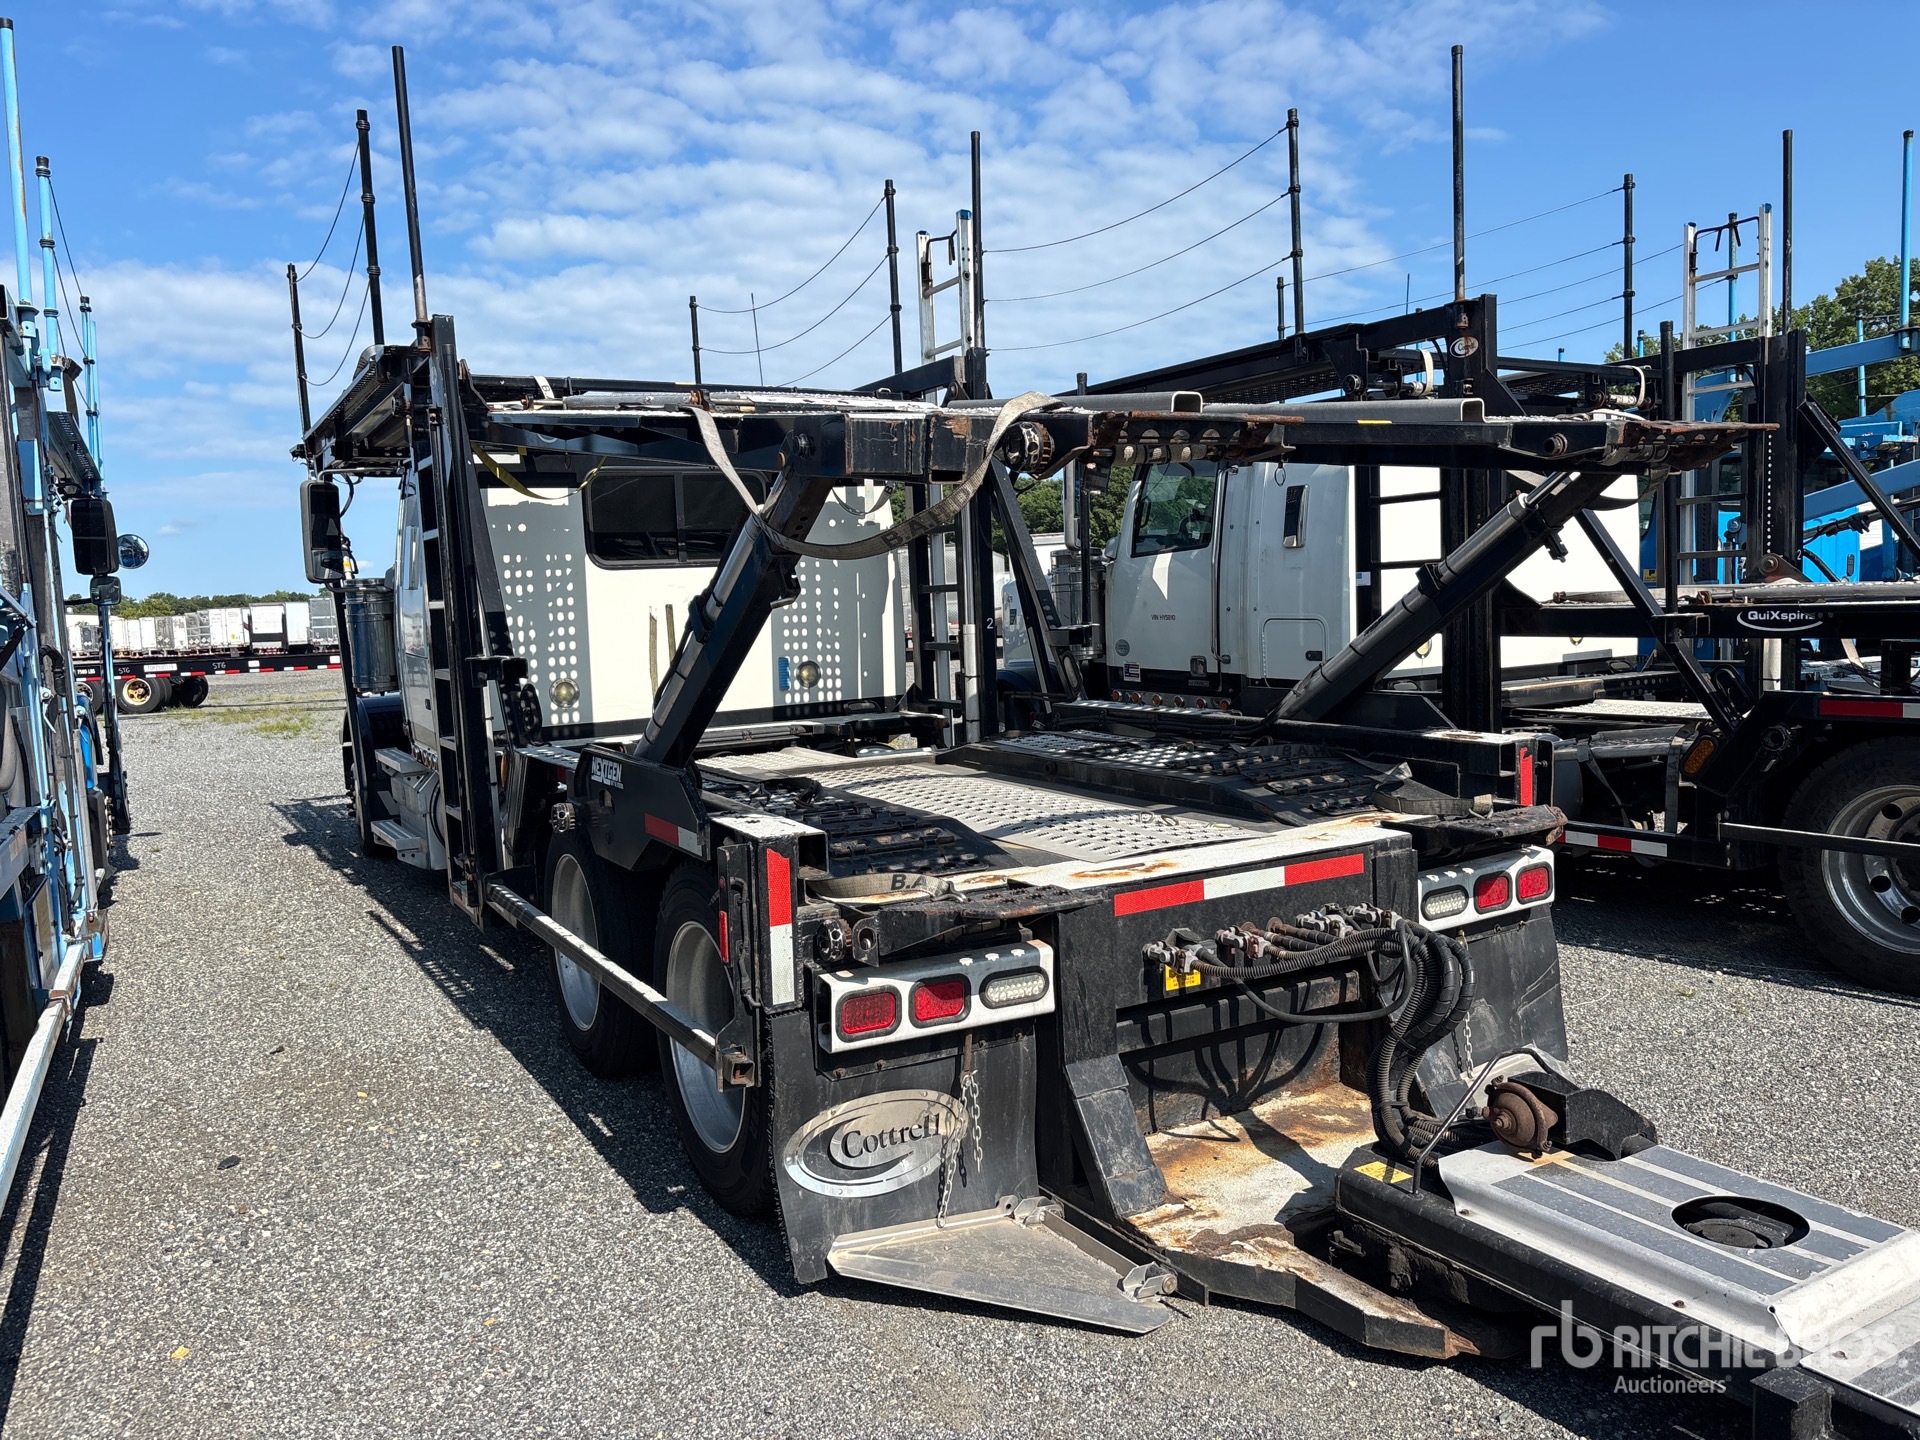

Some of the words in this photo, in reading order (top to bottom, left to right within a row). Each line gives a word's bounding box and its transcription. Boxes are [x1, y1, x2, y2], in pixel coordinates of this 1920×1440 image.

[986, 617, 994, 630] 2
[212, 661, 226, 670] STG
[591, 756, 622, 783] NEXTGEN
[840, 1112, 940, 1159] Cottrell
